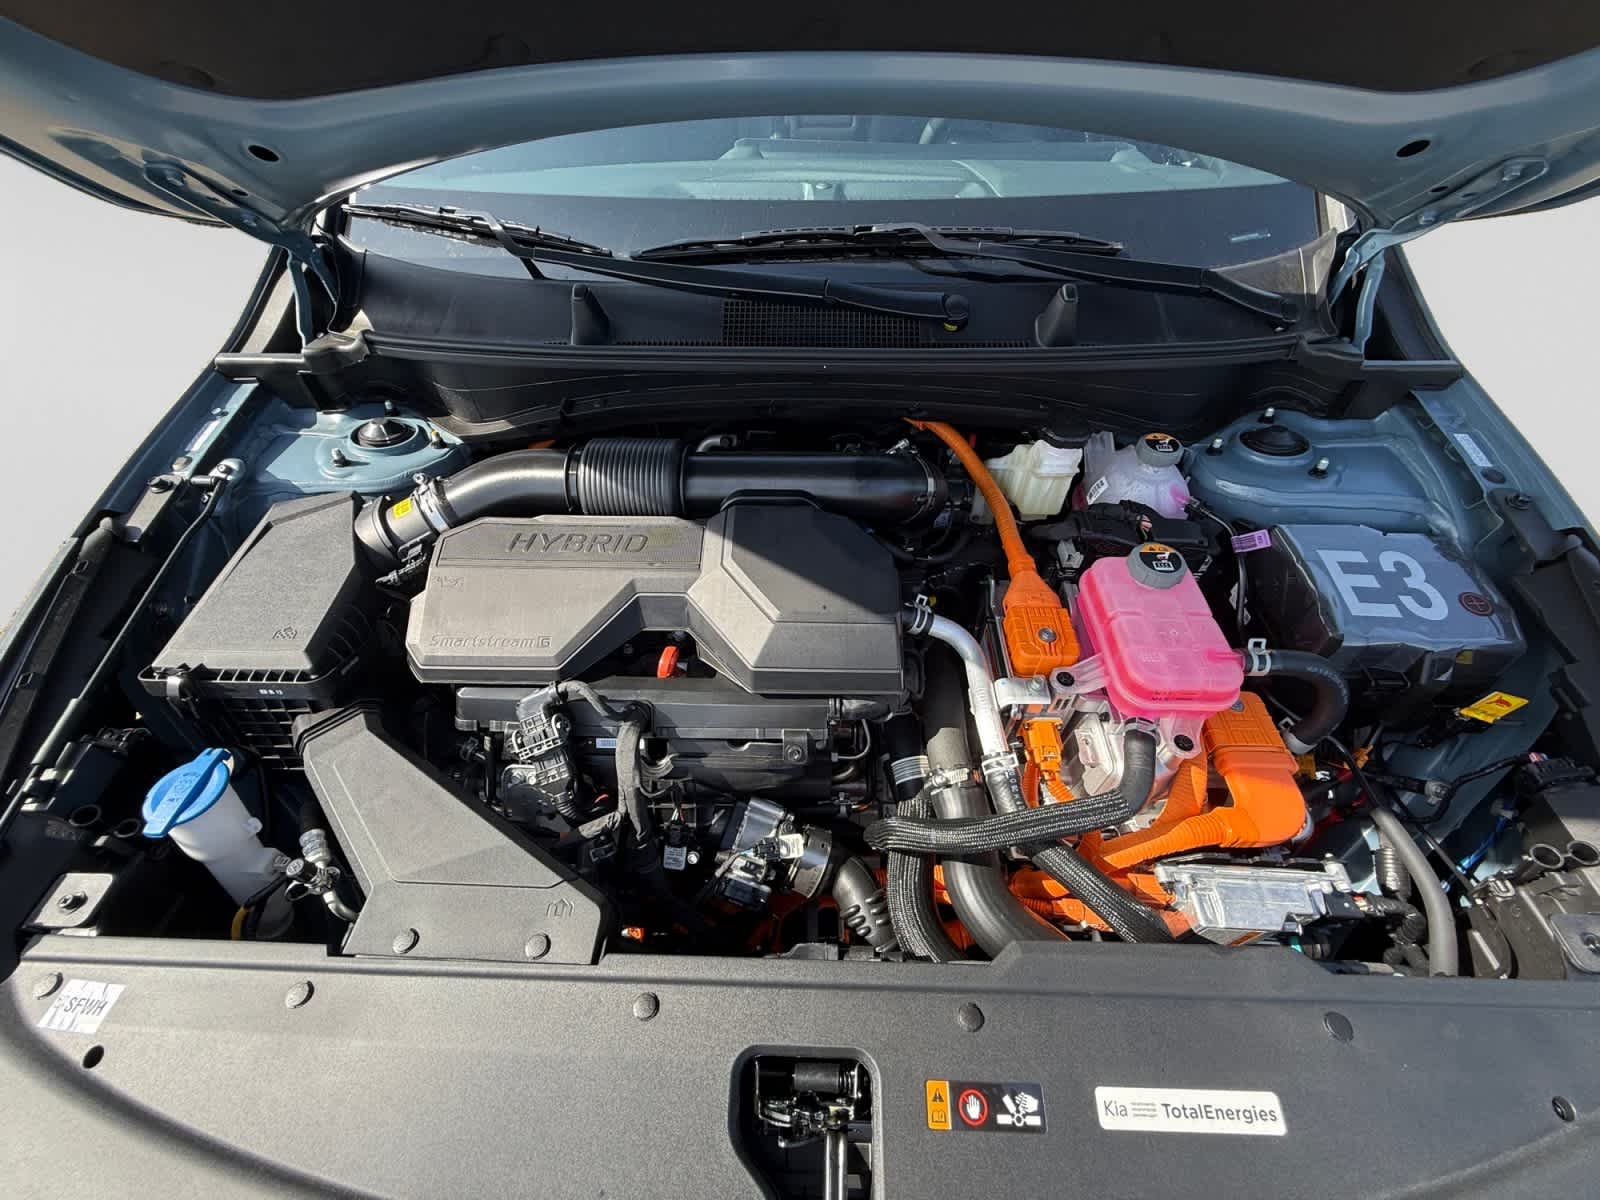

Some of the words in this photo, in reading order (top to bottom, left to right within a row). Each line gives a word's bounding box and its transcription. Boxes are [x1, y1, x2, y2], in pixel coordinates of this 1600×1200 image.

[506, 531, 650, 553] HYBRID
[1316, 550, 1449, 621] E3
[429, 634, 535, 649] Smartstream
[64, 997, 108, 1016] SFWH
[1103, 1100, 1128, 1117] Kia
[1162, 1103, 1277, 1124] TotalEnergies
